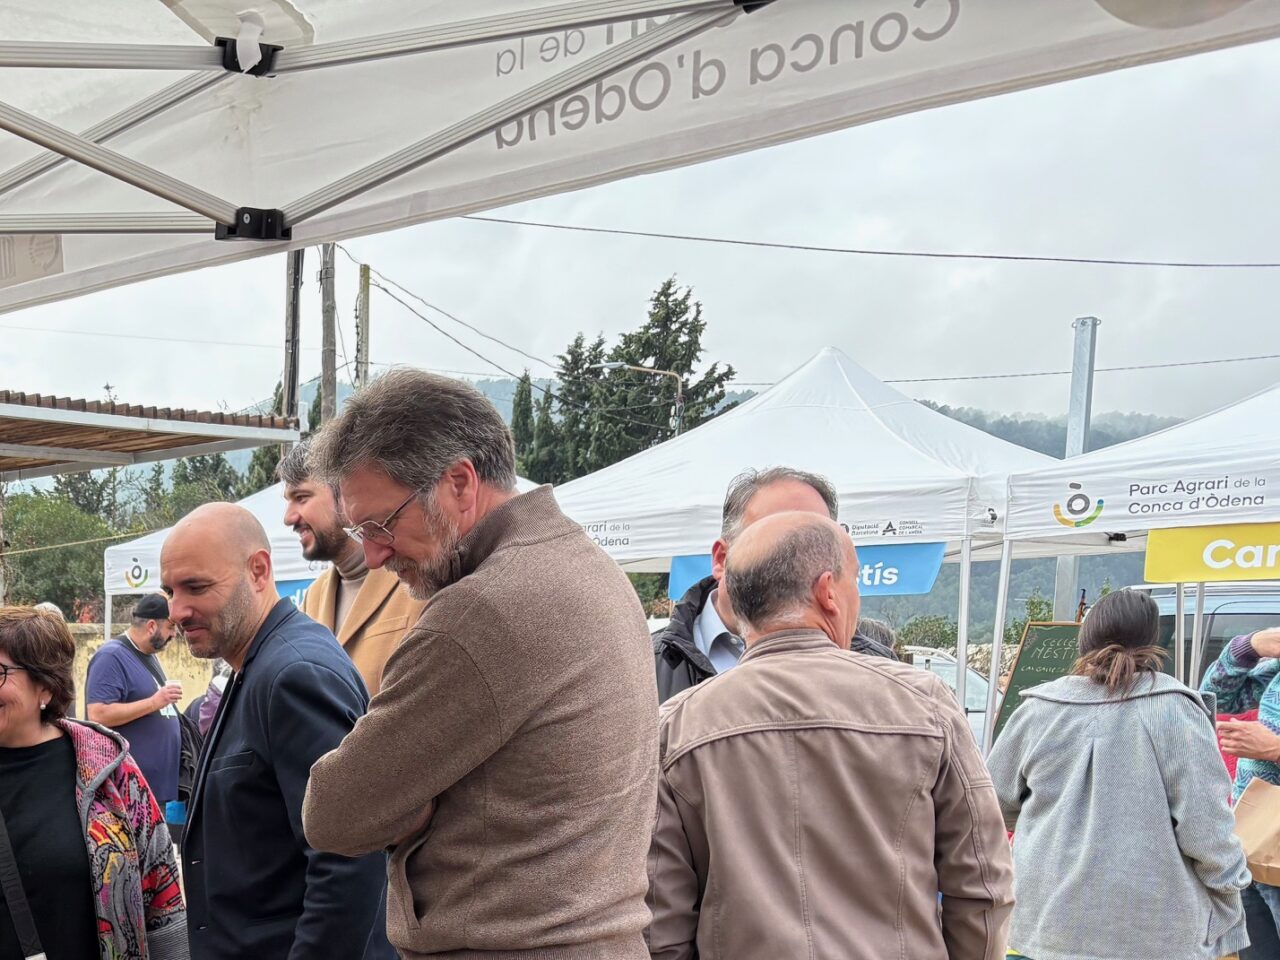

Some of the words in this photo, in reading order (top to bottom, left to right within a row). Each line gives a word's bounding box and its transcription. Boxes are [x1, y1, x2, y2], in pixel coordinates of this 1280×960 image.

[1129, 483, 1168, 497] Parc
[1173, 475, 1229, 497] Agrari
[1233, 477, 1251, 489] de
[1254, 477, 1266, 487] la
[1128, 498, 1183, 515] Conca
[1189, 493, 1265, 512] d'Òdena
[609, 523, 621, 532] de
[622, 522, 631, 531] la
[856, 561, 899, 586] tís
